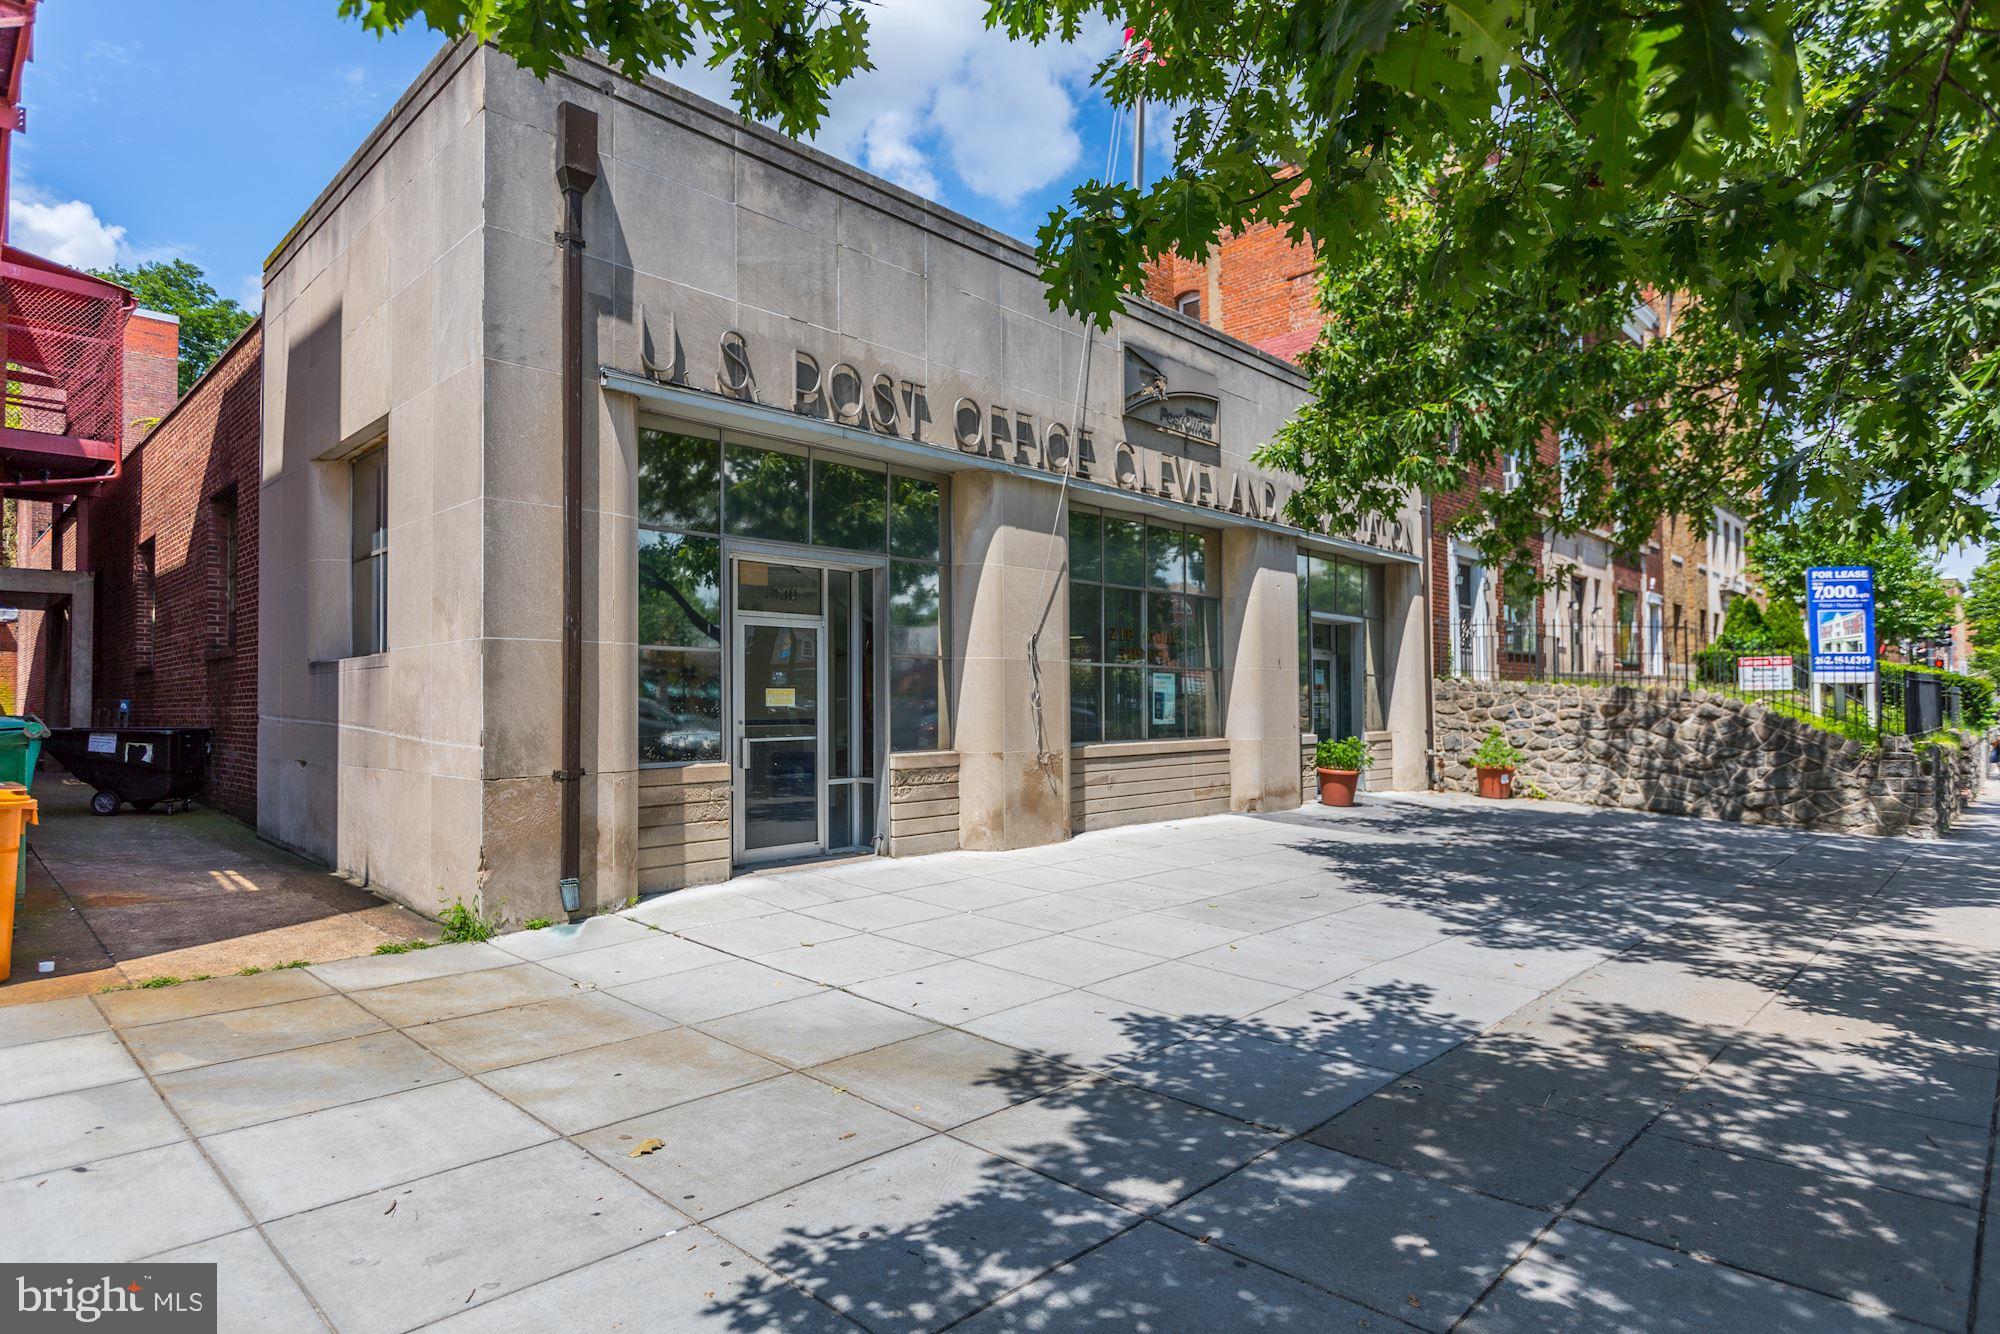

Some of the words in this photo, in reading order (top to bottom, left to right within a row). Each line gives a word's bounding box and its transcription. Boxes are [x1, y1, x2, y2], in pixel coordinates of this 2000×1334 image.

[791, 347, 927, 438] POST
[953, 396, 1094, 477] OFFICE
[1114, 440, 1277, 522] CLEVELAND
[1811, 570, 1834, 579] FOR
[1834, 569, 1869, 579] LEASE
